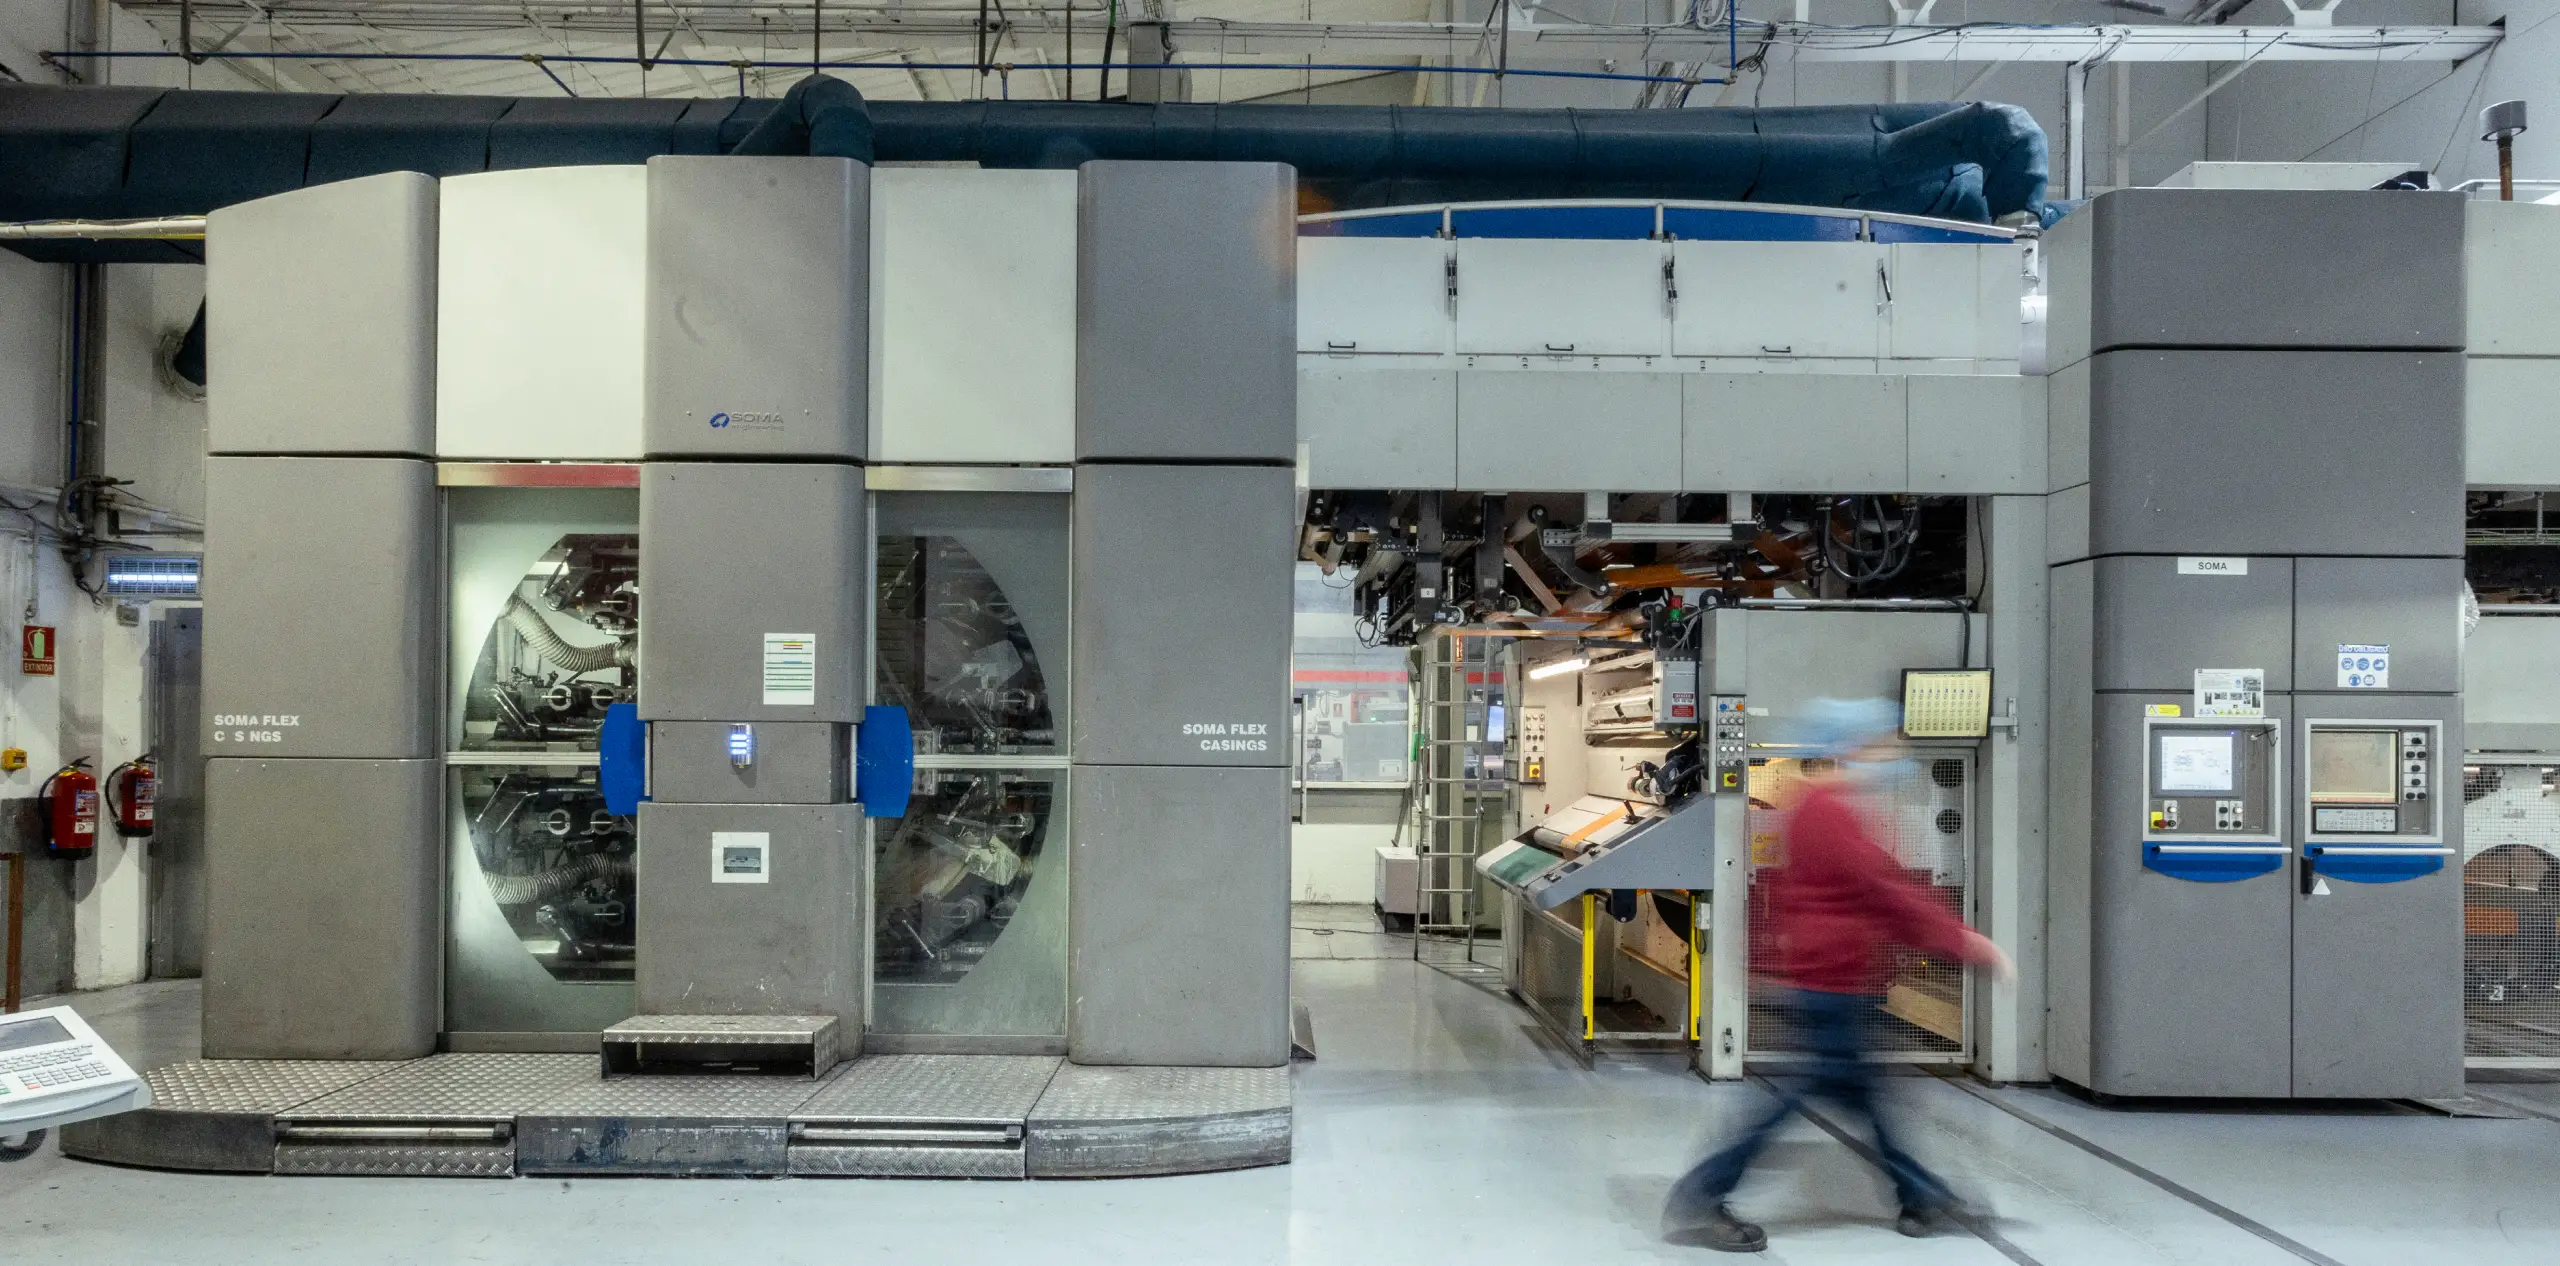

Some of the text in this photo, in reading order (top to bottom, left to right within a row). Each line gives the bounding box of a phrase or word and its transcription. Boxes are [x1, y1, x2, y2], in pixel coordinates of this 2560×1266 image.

[731, 412, 784, 424] SOMA
[2198, 561, 2228, 571] SOMA
[214, 714, 300, 726] SOMA FLEX
[1182, 723, 1268, 735] SOMA FLEX
[1200, 739, 1268, 751] CASINGS
